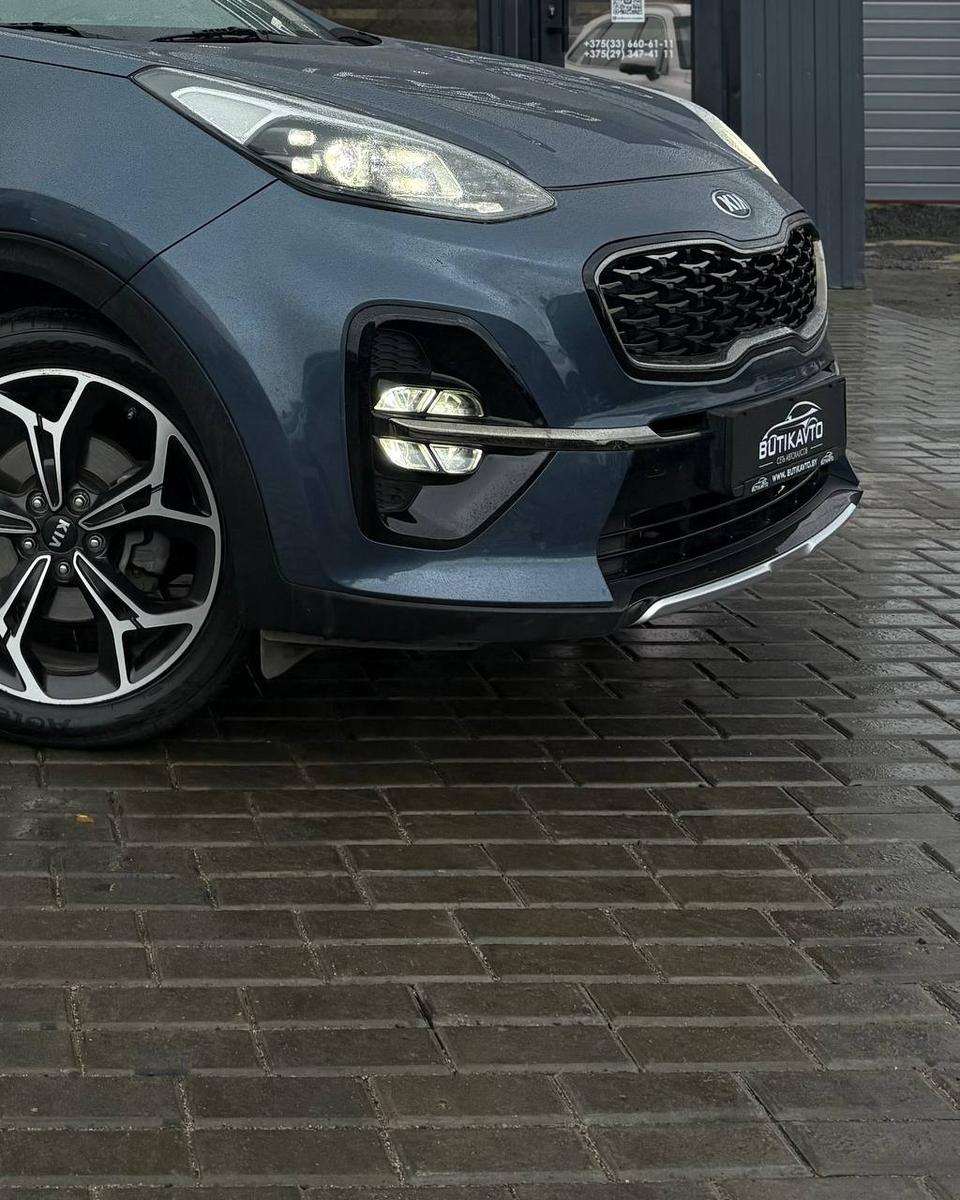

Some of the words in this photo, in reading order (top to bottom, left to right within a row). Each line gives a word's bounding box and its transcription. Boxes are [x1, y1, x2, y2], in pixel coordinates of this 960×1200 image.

[584, 39, 625, 50] +375(33)
[627, 40, 674, 49] 660-61-11
[584, 49, 625, 60] +375(29)
[627, 49, 674, 58] 347-4111
[758, 421, 824, 460] BUTIKAVTO
[49, 519, 70, 547] KIA
